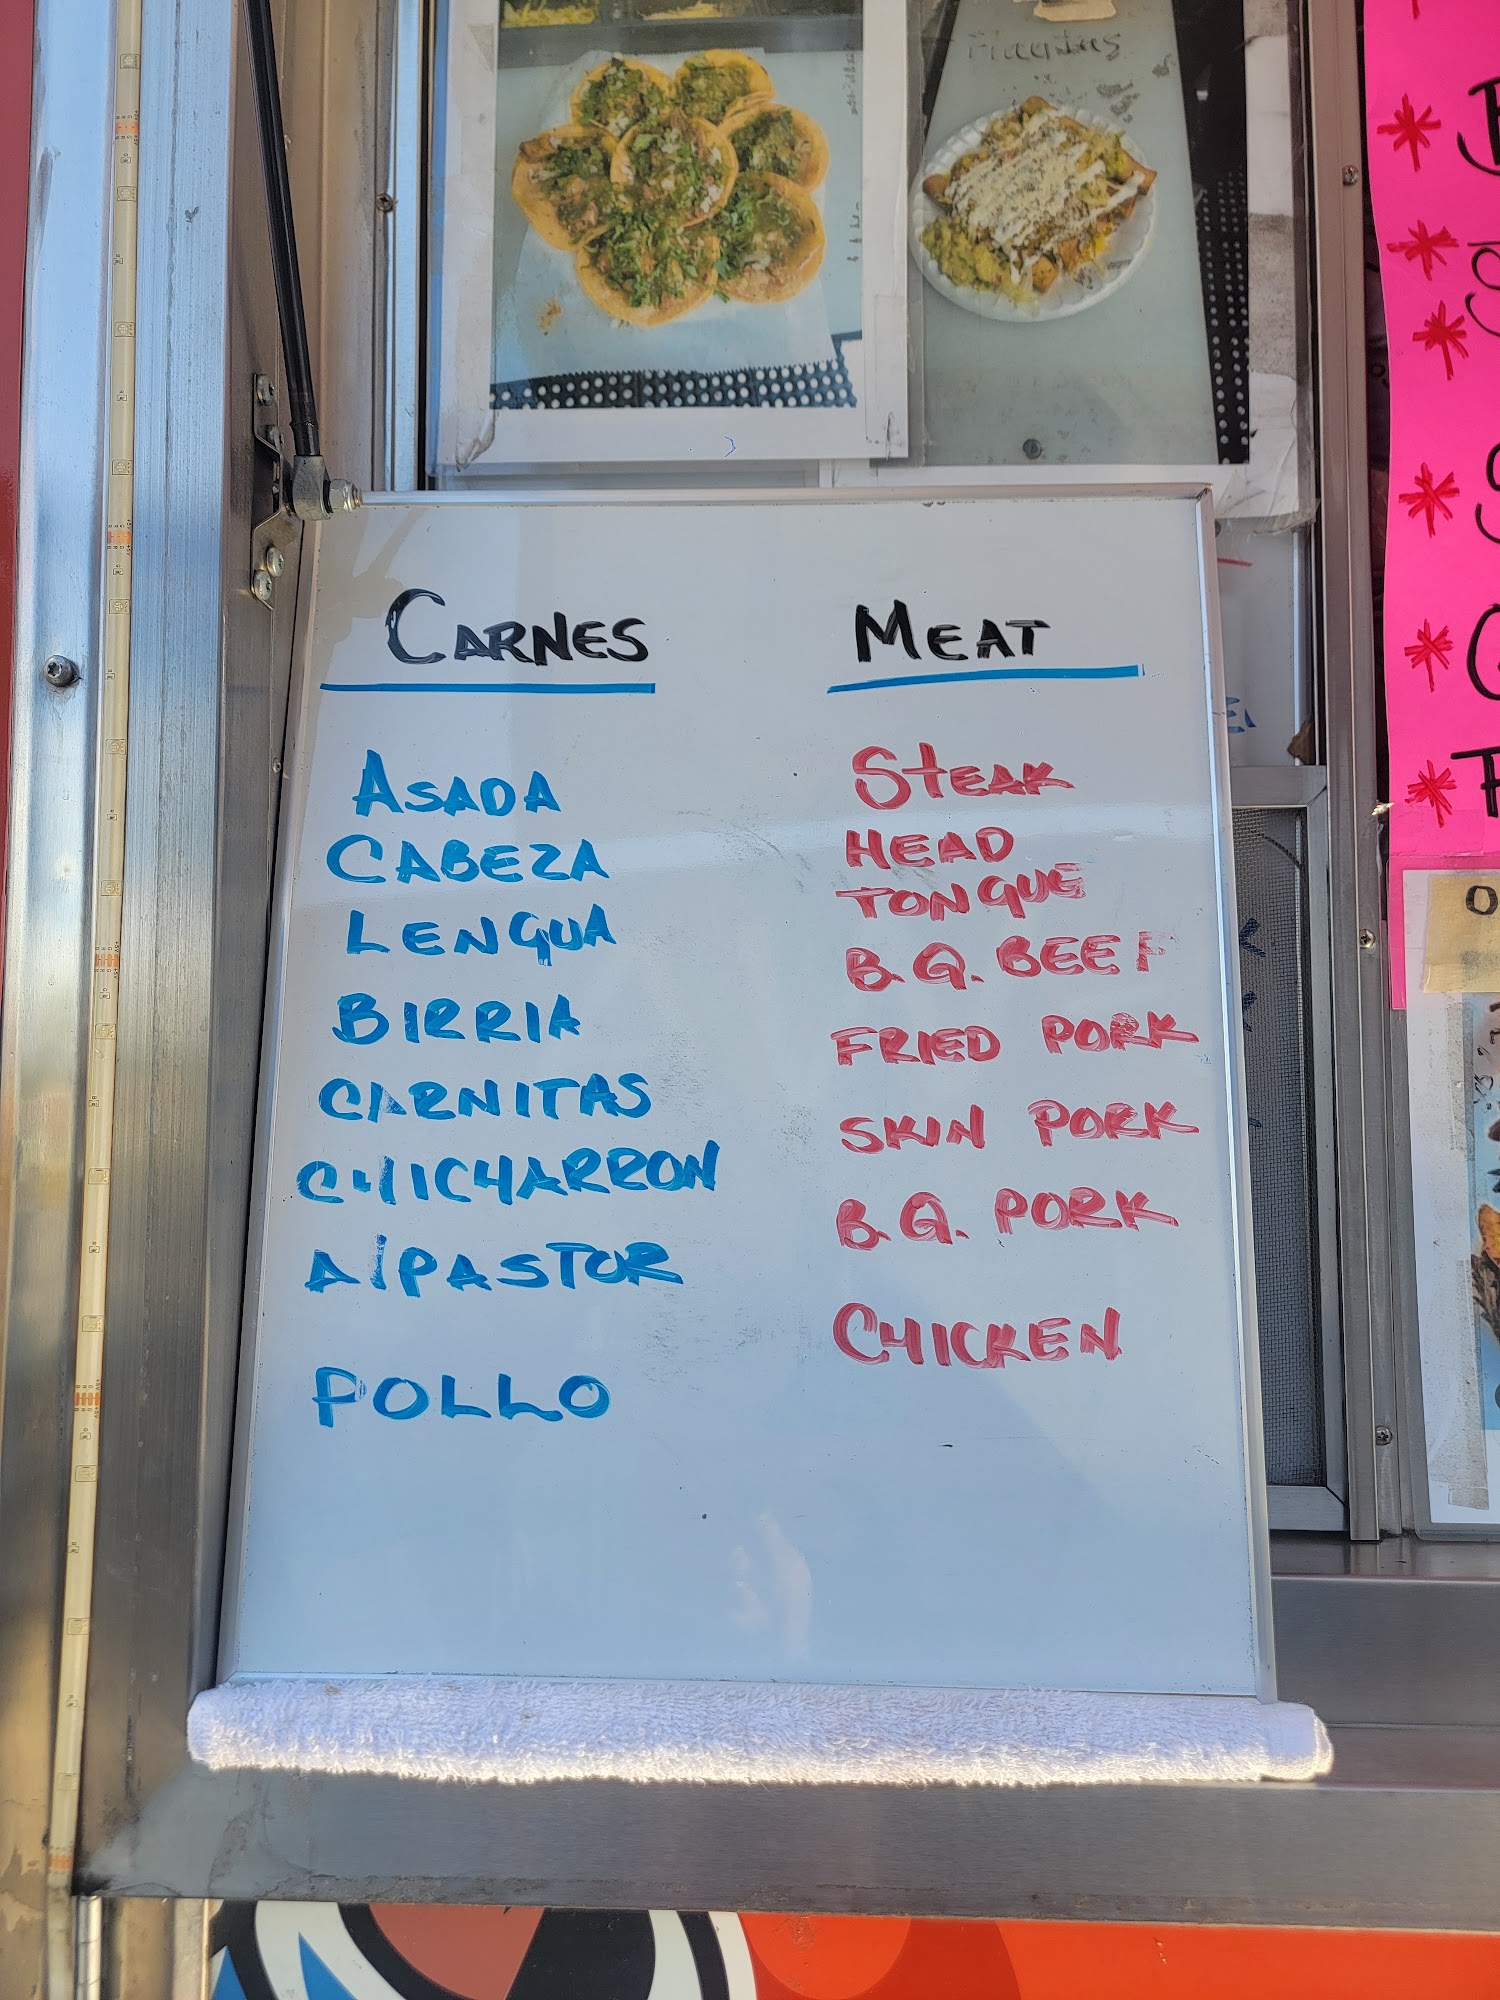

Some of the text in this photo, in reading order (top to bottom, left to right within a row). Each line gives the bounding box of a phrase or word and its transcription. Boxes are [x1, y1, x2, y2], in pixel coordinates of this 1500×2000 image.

[384, 588, 649, 667] CARNES
[855, 599, 1051, 662] MEAT
[352, 749, 561, 817] ASADA
[326, 833, 610, 884] CABEZA
[846, 826, 1014, 870] HEAD
[346, 903, 617, 967] LENGUA
[995, 930, 1175, 978] BEEF
[331, 992, 581, 1045] BIRRIA
[830, 1025, 1001, 1066] FRIED
[1041, 1010, 1200, 1054] PORK
[318, 1072, 653, 1123] CARNITAS
[839, 1099, 1200, 1154] SKIN PORK
[296, 1139, 721, 1206] CHICHARRON
[994, 1186, 1180, 1235] PORK
[833, 1302, 1124, 1369] CHICKEN
[311, 1366, 612, 1429] POLLO
